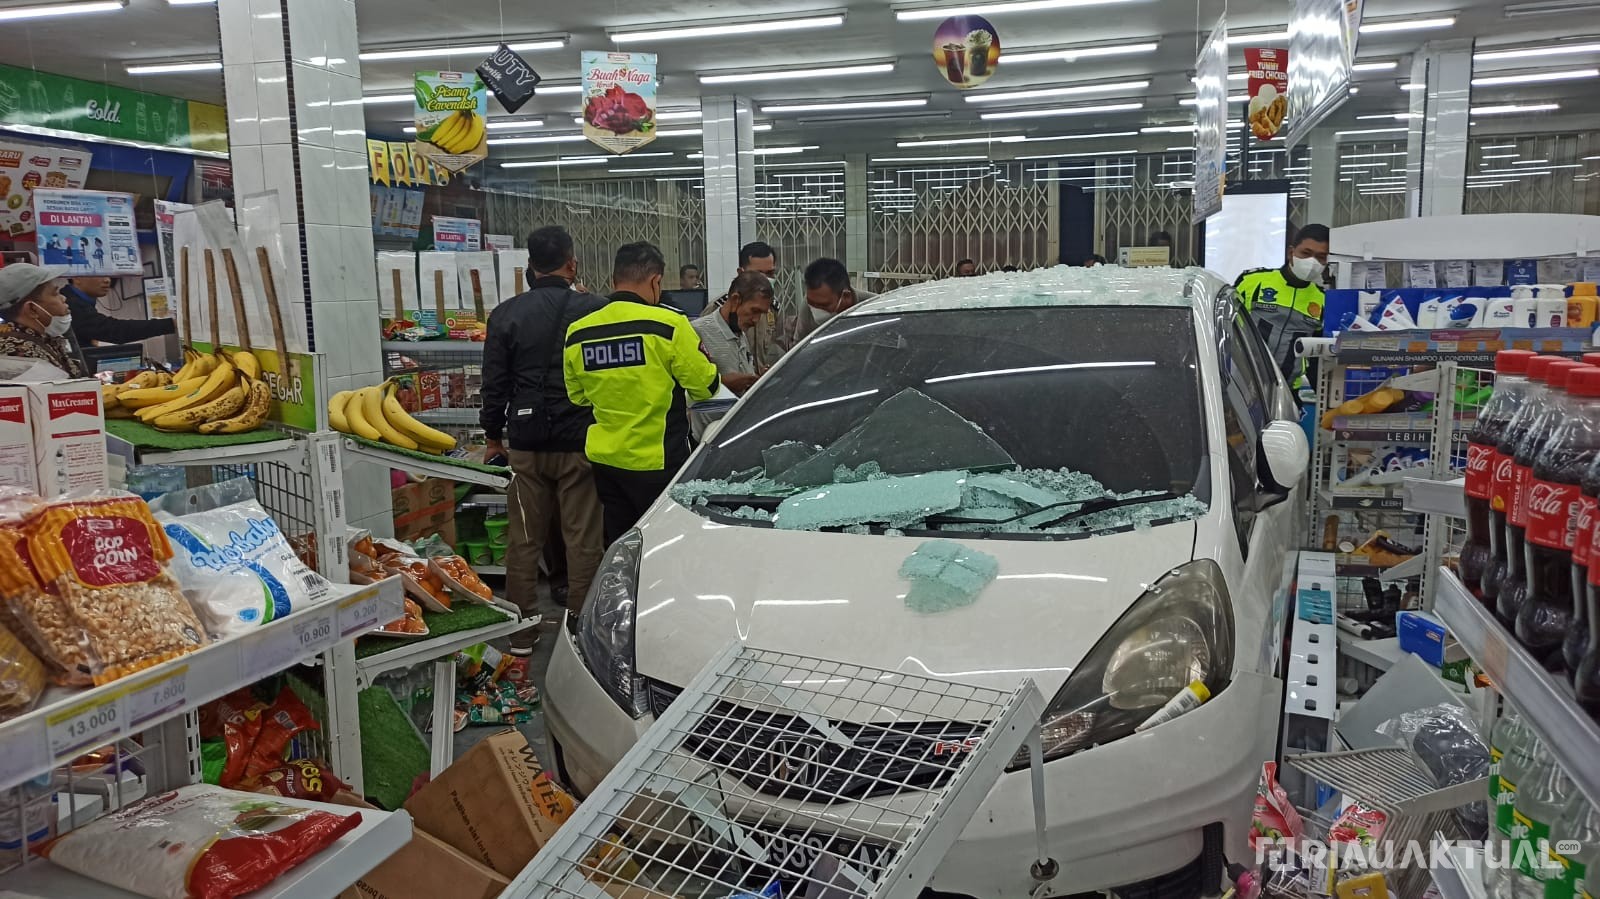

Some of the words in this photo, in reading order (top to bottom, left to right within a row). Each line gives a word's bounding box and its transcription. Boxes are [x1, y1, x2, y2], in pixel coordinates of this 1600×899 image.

[1249, 70, 1264, 79] FRIED
[1257, 61, 1279, 71] YUMMY
[587, 68, 618, 81] Buah
[624, 68, 650, 86] Naga
[431, 84, 470, 101] Pisang
[426, 97, 478, 112] Cavendish
[50, 215, 59, 223] DI
[61, 215, 93, 224] LANTAI
[583, 342, 642, 366] POLISI
[51, 398, 95, 408] MaxCreamer
[1387, 433, 1425, 441] LEBIH
[1511, 482, 1521, 522] RECYCLE
[94, 536, 124, 553] POP
[93, 547, 138, 568] CORN
[353, 603, 378, 619] 9.200
[300, 624, 331, 645] 10.900
[152, 681, 186, 705] 7.800
[67, 708, 118, 738] 13.000
[519, 743, 563, 818] WATER
